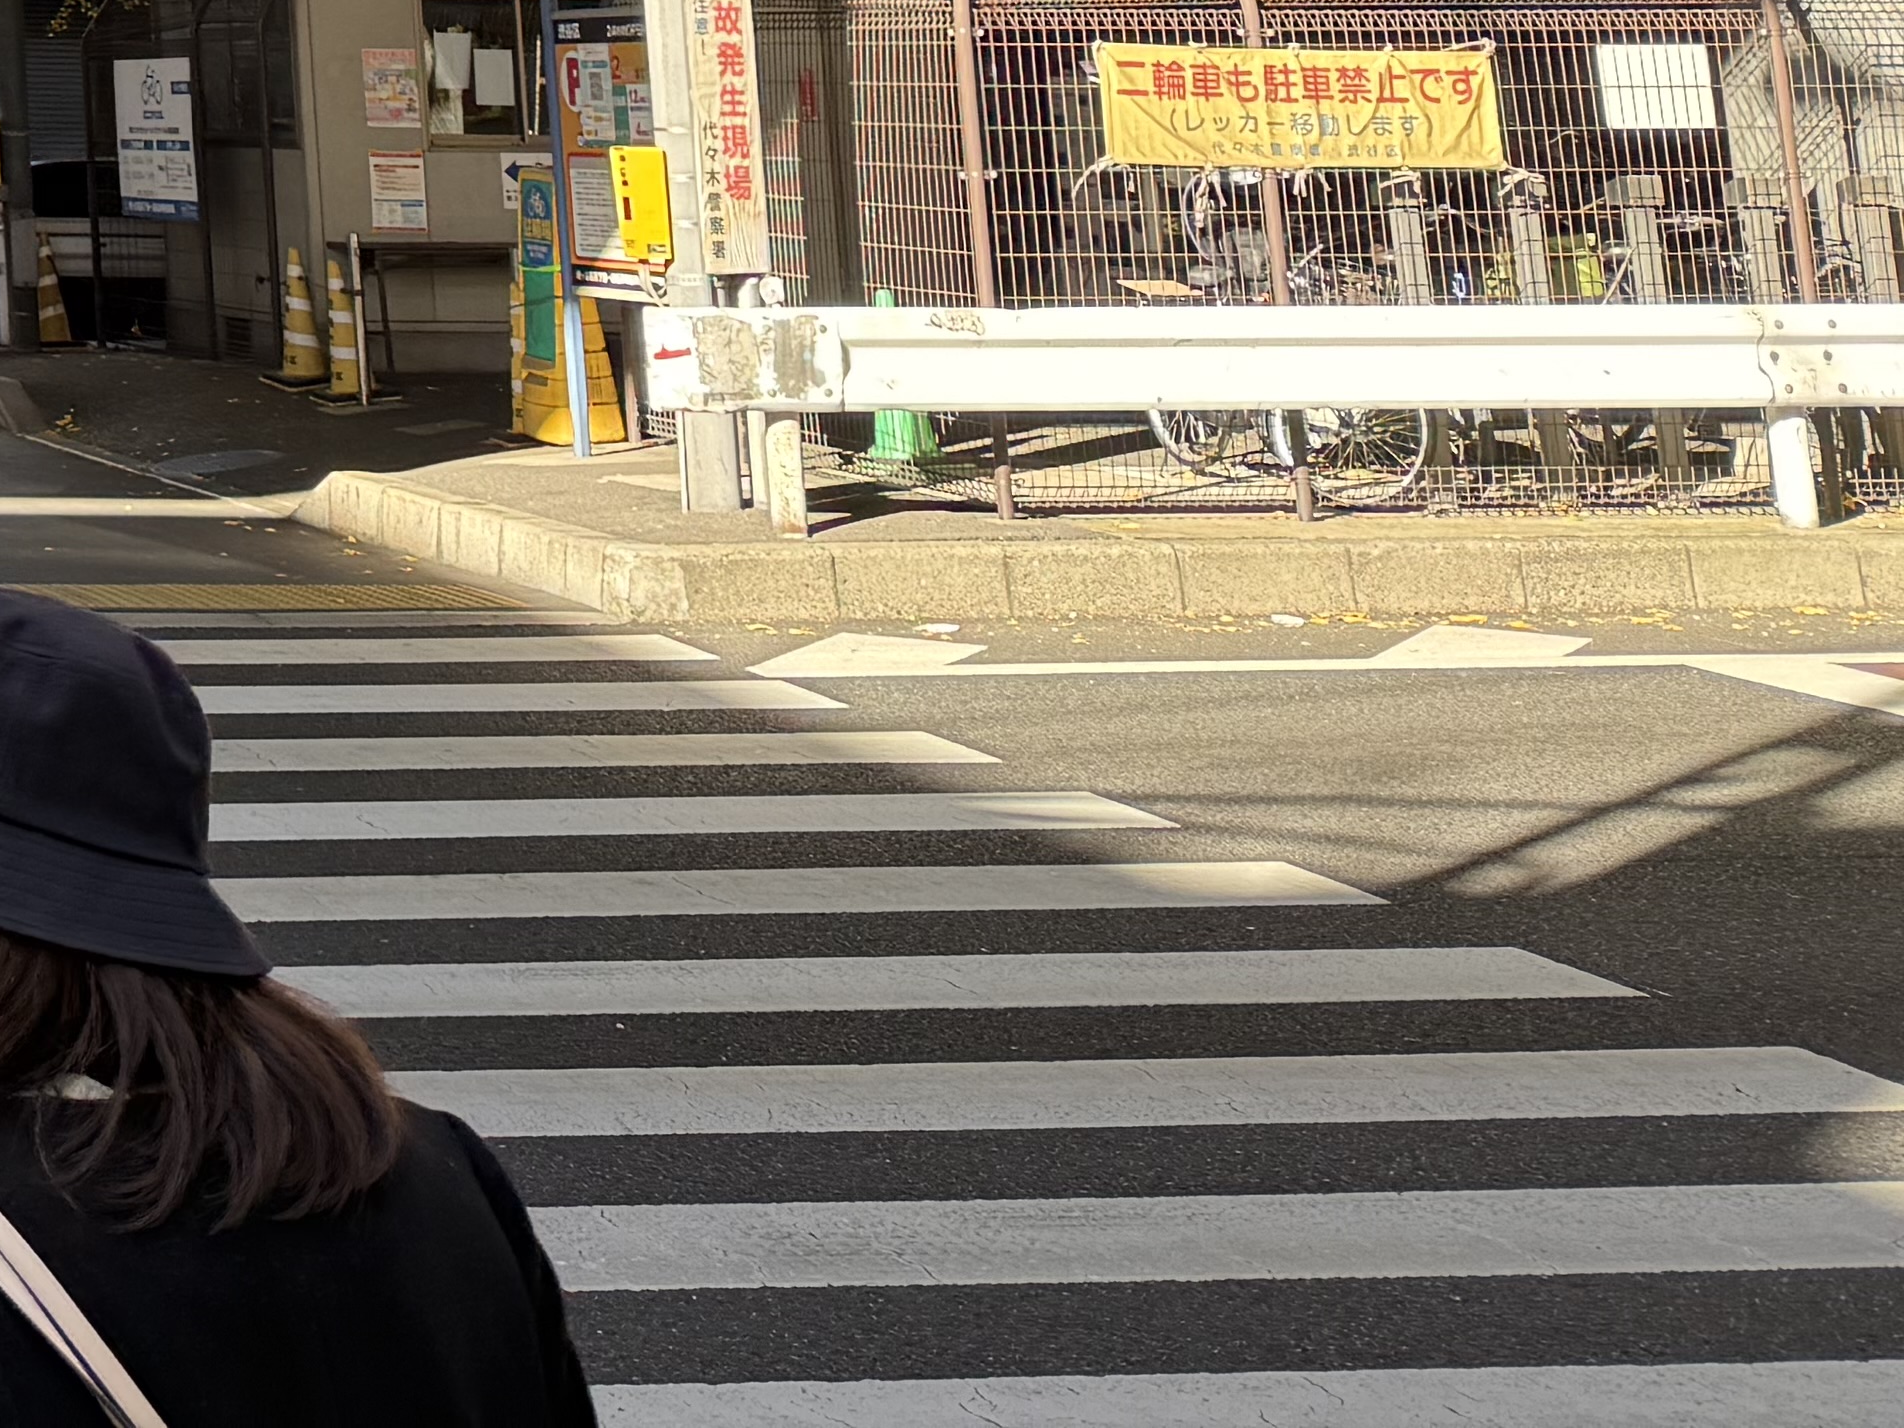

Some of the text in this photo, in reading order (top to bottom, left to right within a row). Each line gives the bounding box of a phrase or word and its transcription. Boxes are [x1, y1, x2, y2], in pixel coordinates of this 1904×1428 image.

[1116, 58, 1479, 106] 二輪車も駐車禁止です
[702, 121, 727, 260] 代々木警察署
